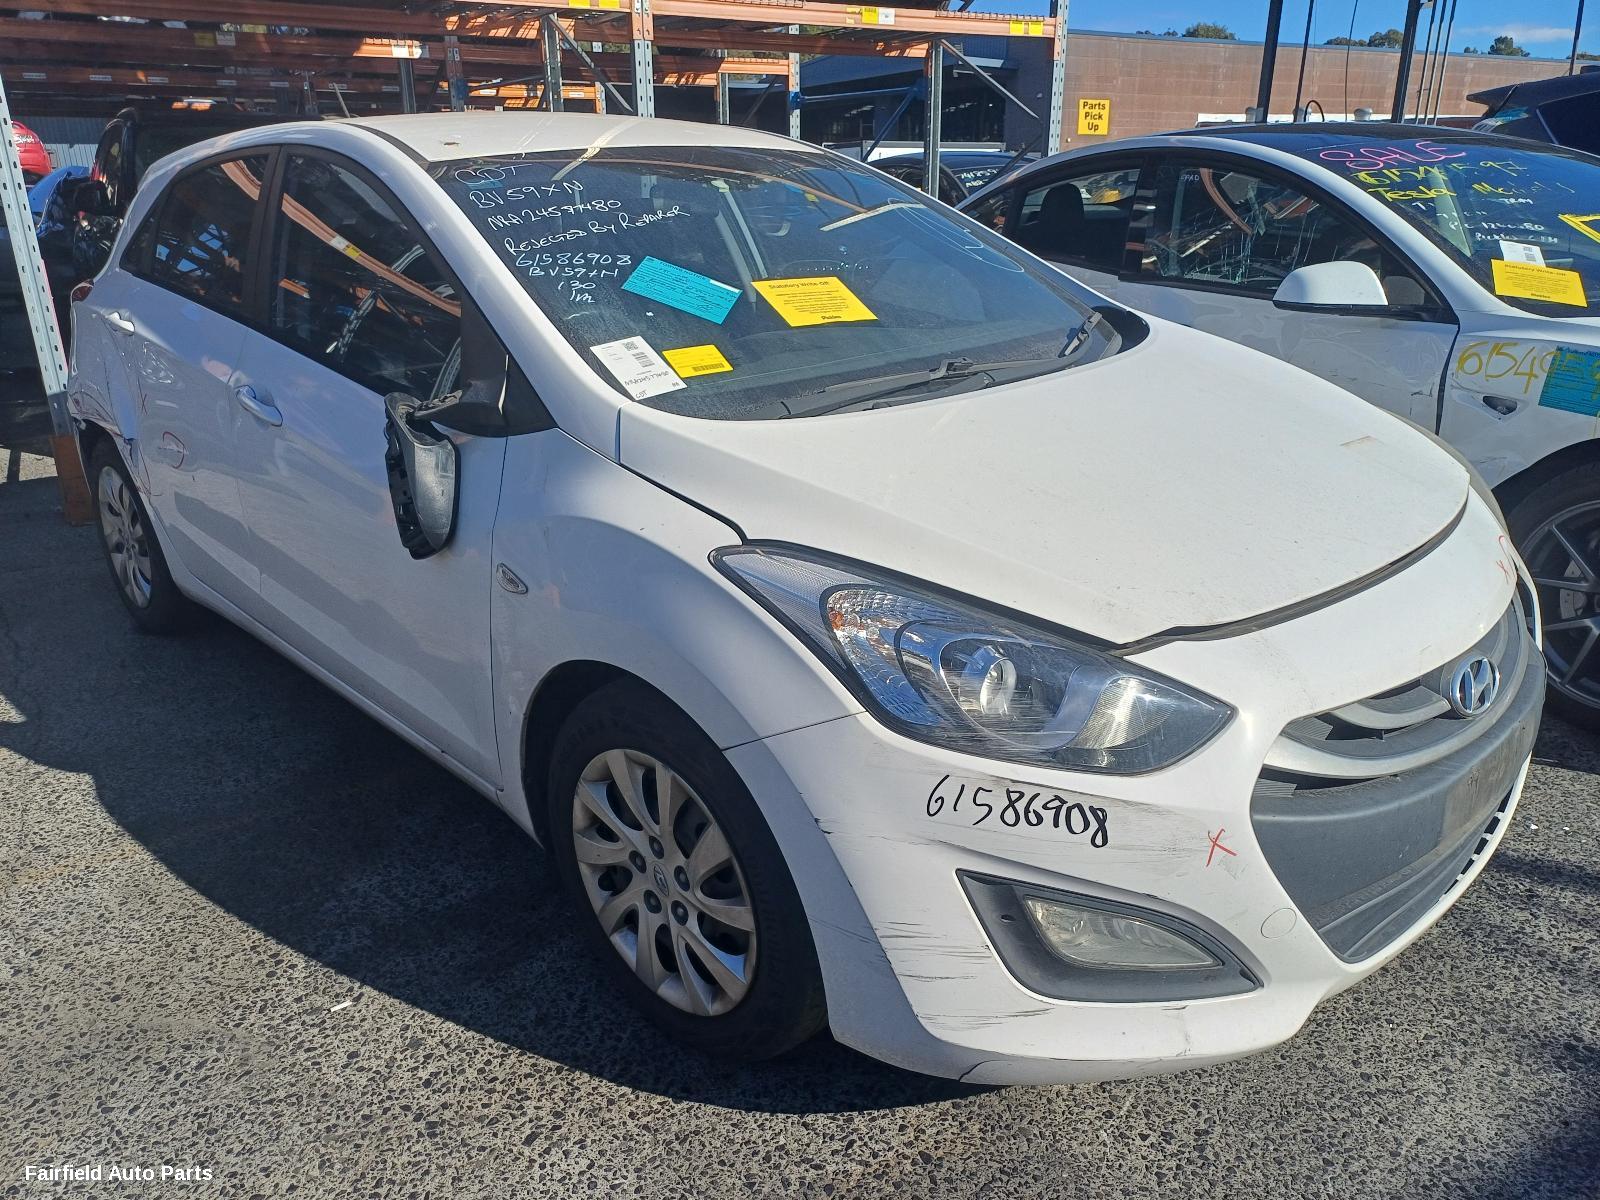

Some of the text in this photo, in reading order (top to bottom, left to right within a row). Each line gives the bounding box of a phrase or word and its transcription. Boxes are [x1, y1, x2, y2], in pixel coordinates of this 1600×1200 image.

[1082, 101, 1106, 110] Parts
[1084, 111, 1104, 120] Pick
[1087, 121, 1100, 132] Up
[1319, 140, 1467, 170] SALE
[515, 252, 633, 268] 61586908
[926, 774, 1109, 848] 61586908
